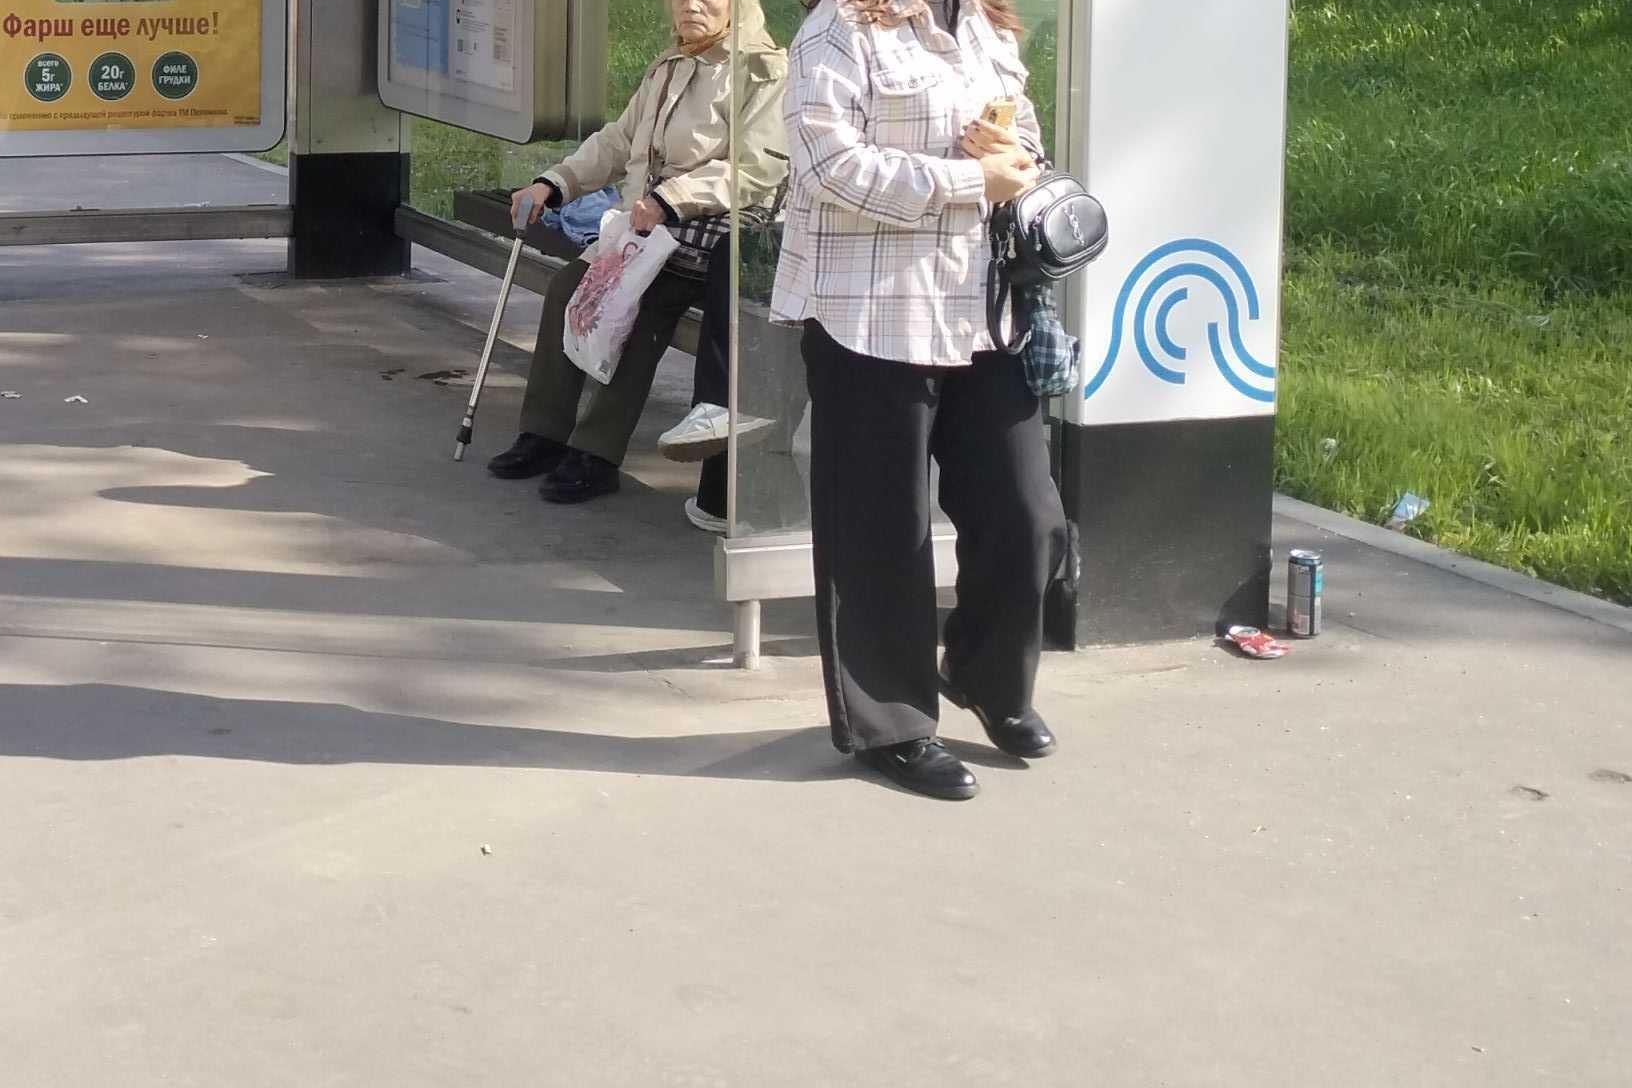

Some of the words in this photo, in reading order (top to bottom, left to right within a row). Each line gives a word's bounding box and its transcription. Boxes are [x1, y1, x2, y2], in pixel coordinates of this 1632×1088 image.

[2, 12, 74, 42] Фарш
[80, 17, 131, 40] еще
[136, 11, 219, 41] лучше!
[41, 67, 56, 82] 5г
[101, 64, 126, 80] 20г
[162, 64, 188, 74] ФИЛЕ
[158, 74, 191, 86] ГРУДКИ
